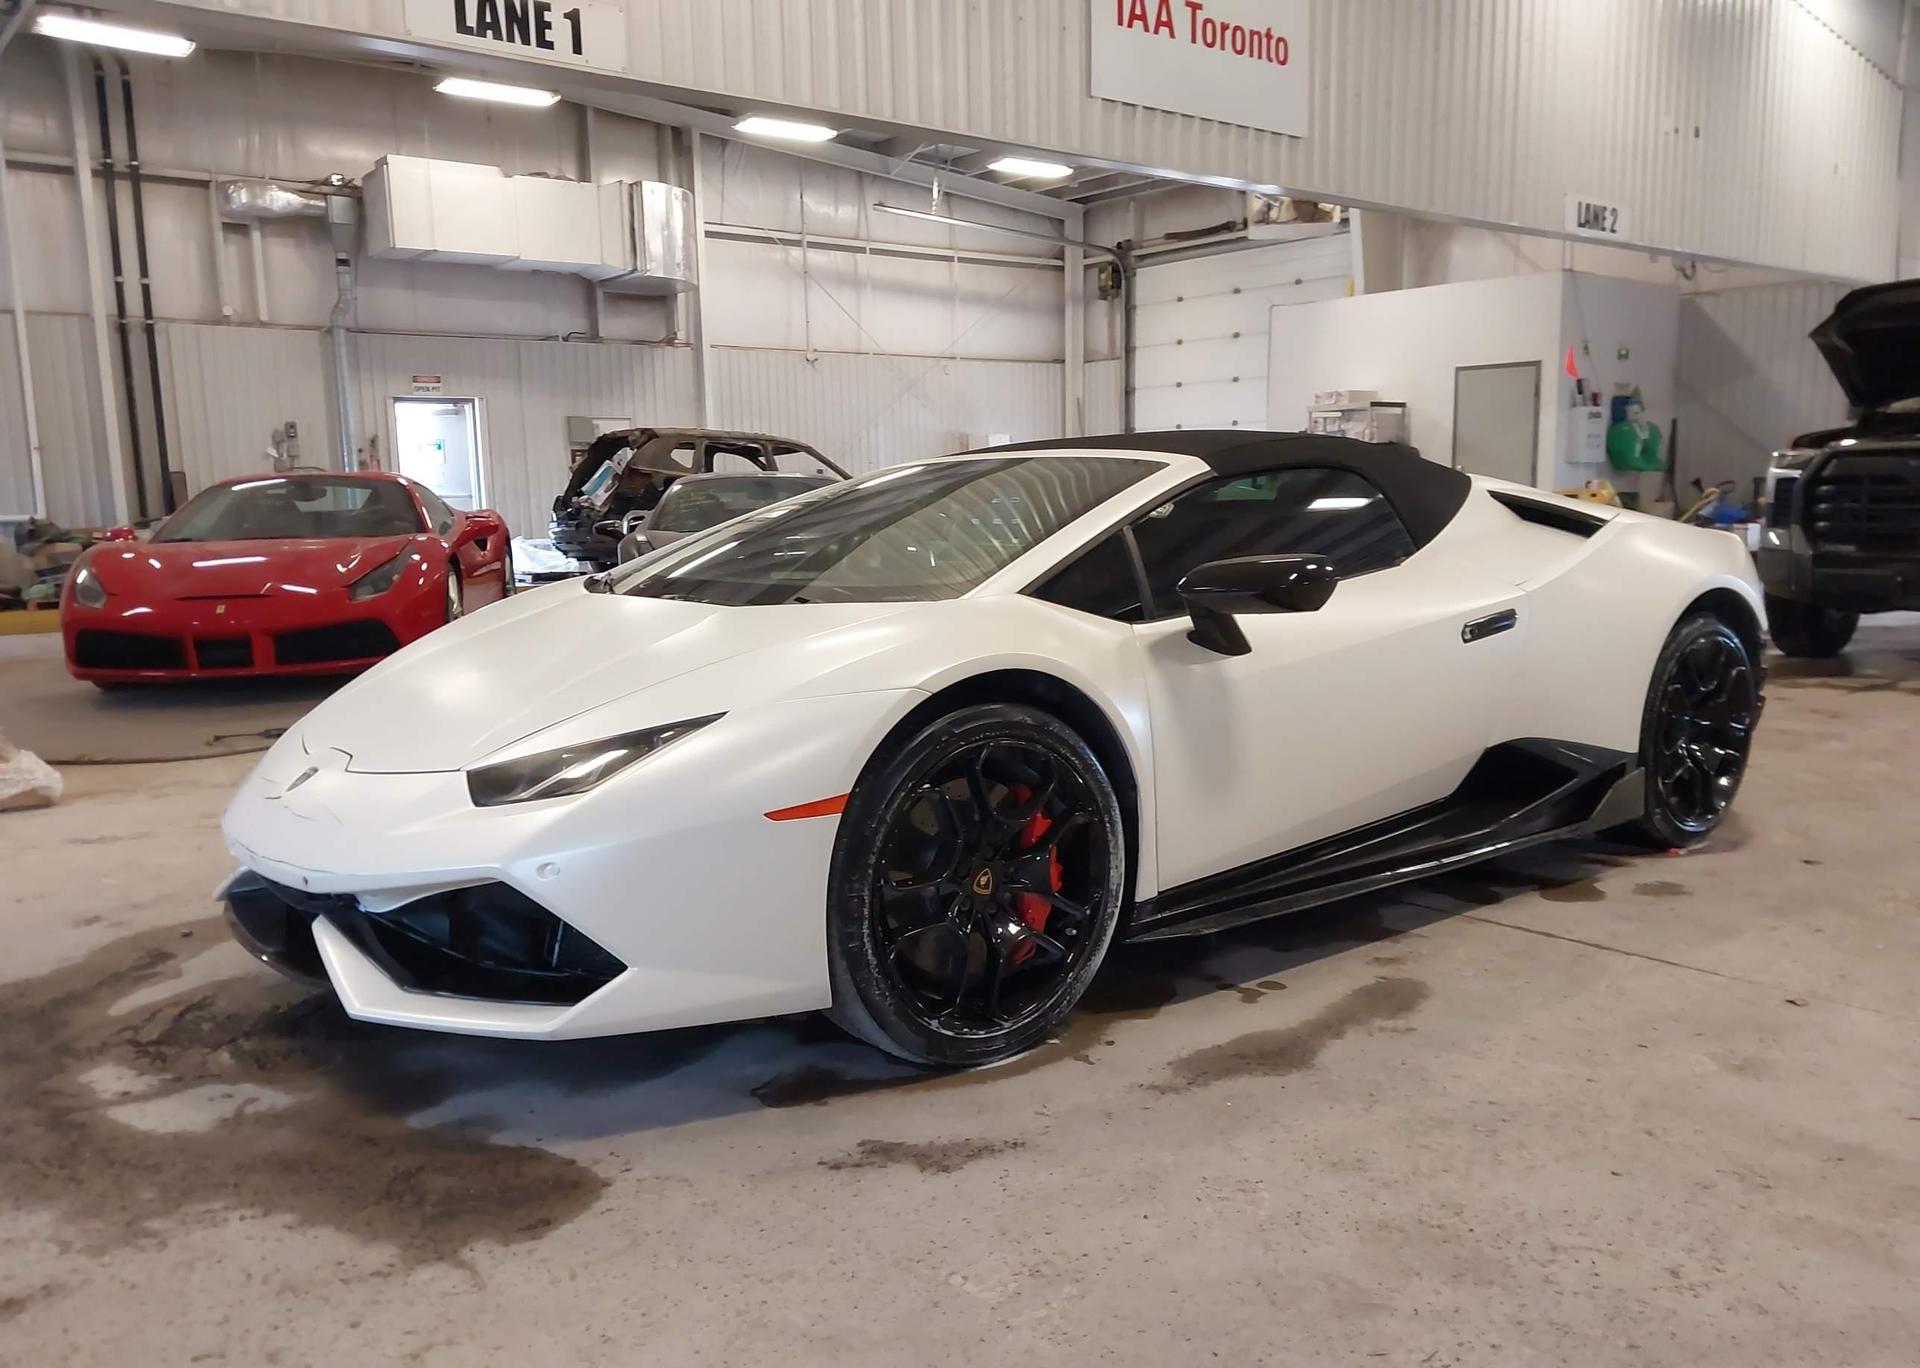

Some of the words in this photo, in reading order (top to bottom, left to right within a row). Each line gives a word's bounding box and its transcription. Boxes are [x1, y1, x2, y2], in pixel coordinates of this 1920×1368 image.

[454, 0, 555, 50] LANE
[563, 8, 583, 55] 1
[1116, 0, 1176, 39] IAA
[1184, 0, 1289, 66] Toronto
[1577, 201, 1607, 232] LANE
[1609, 207, 1618, 234] 2
